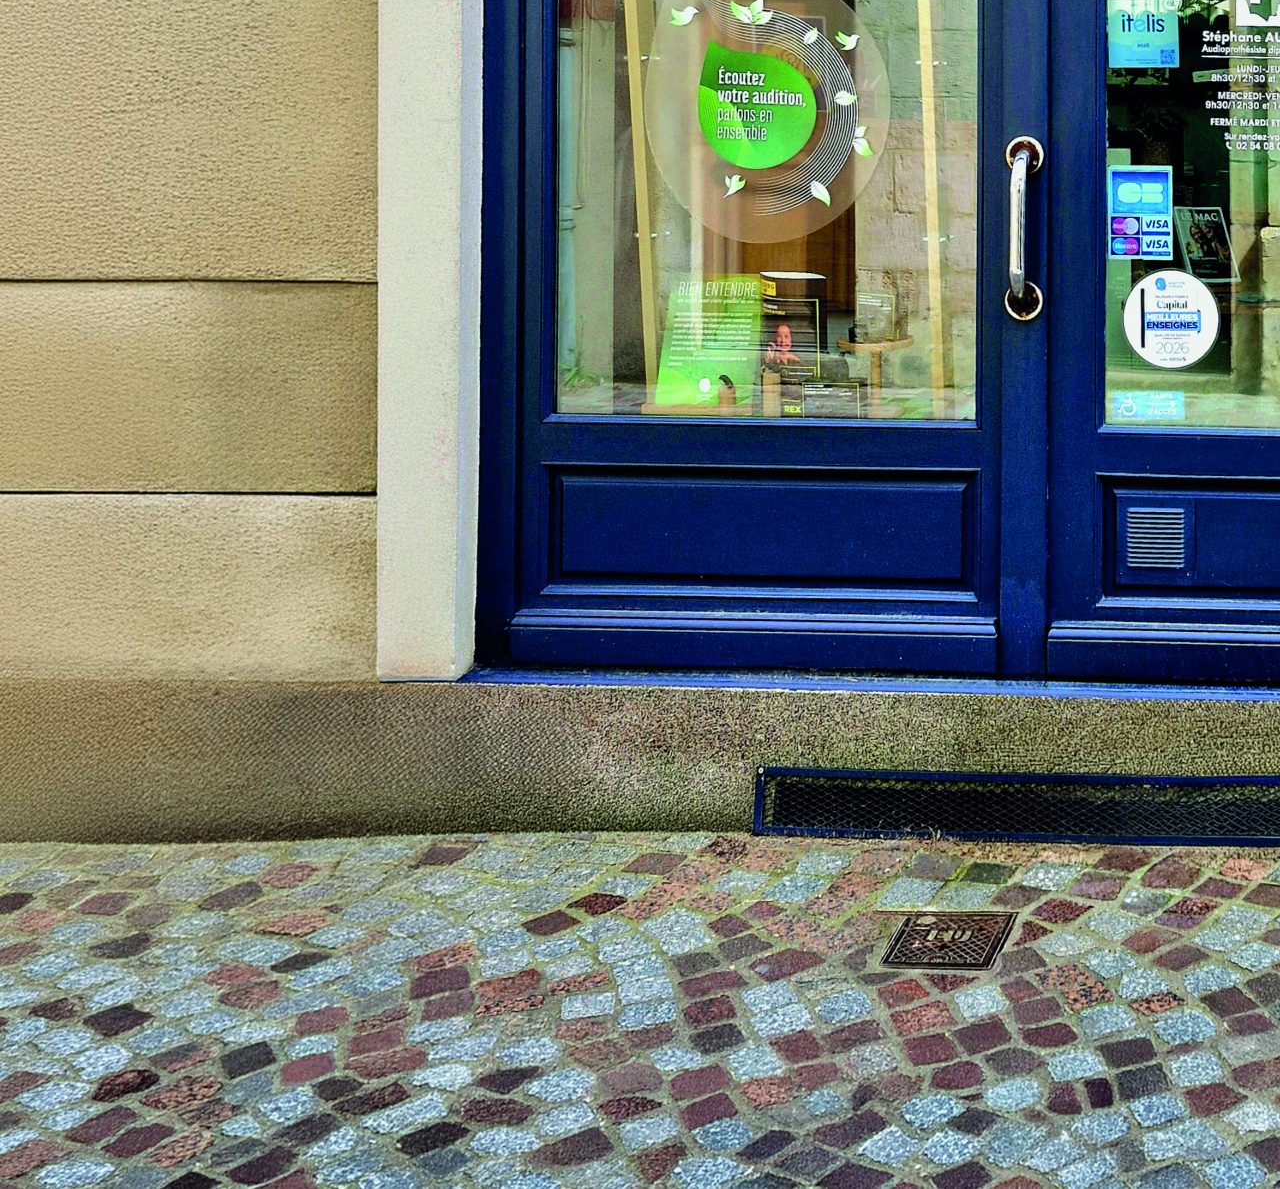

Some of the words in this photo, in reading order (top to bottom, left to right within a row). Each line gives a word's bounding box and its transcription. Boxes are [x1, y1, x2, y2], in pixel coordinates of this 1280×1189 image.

[1121, 14, 1165, 33] itelis
[1202, 31, 1262, 45] Stéphane
[1201, 43, 1267, 55] Audioprothésiste
[718, 65, 766, 86] Écoutez
[1211, 73, 1266, 83] 8h30/12h30
[717, 88, 750, 104] votre
[752, 88, 807, 108] audition,
[1205, 100, 1260, 110] 9h30/12h30
[1262, 102, 1270, 110] et
[717, 105, 773, 123] parlons-en
[1210, 116, 1239, 127] FERMÉ
[1240, 118, 1269, 127] MARDI
[1271, 119, 1280, 127] ET
[717, 124, 768, 141] ensemble
[1224, 132, 1238, 141] Sur
[1235, 142, 1248, 151] 02
[1249, 142, 1262, 151] 54
[1263, 142, 1275, 151] 08
[1194, 213, 1219, 222] MAG
[1145, 219, 1169, 229] VISA
[1145, 238, 1169, 249] VISA
[678, 280, 704, 297] BIEN
[705, 281, 758, 298] ENTENDRE
[1156, 299, 1188, 311] Capital
[1146, 313, 1199, 322] MEILLEURES
[1146, 321, 1199, 329] ENSEIGNES
[1155, 341, 1190, 355] 2026
